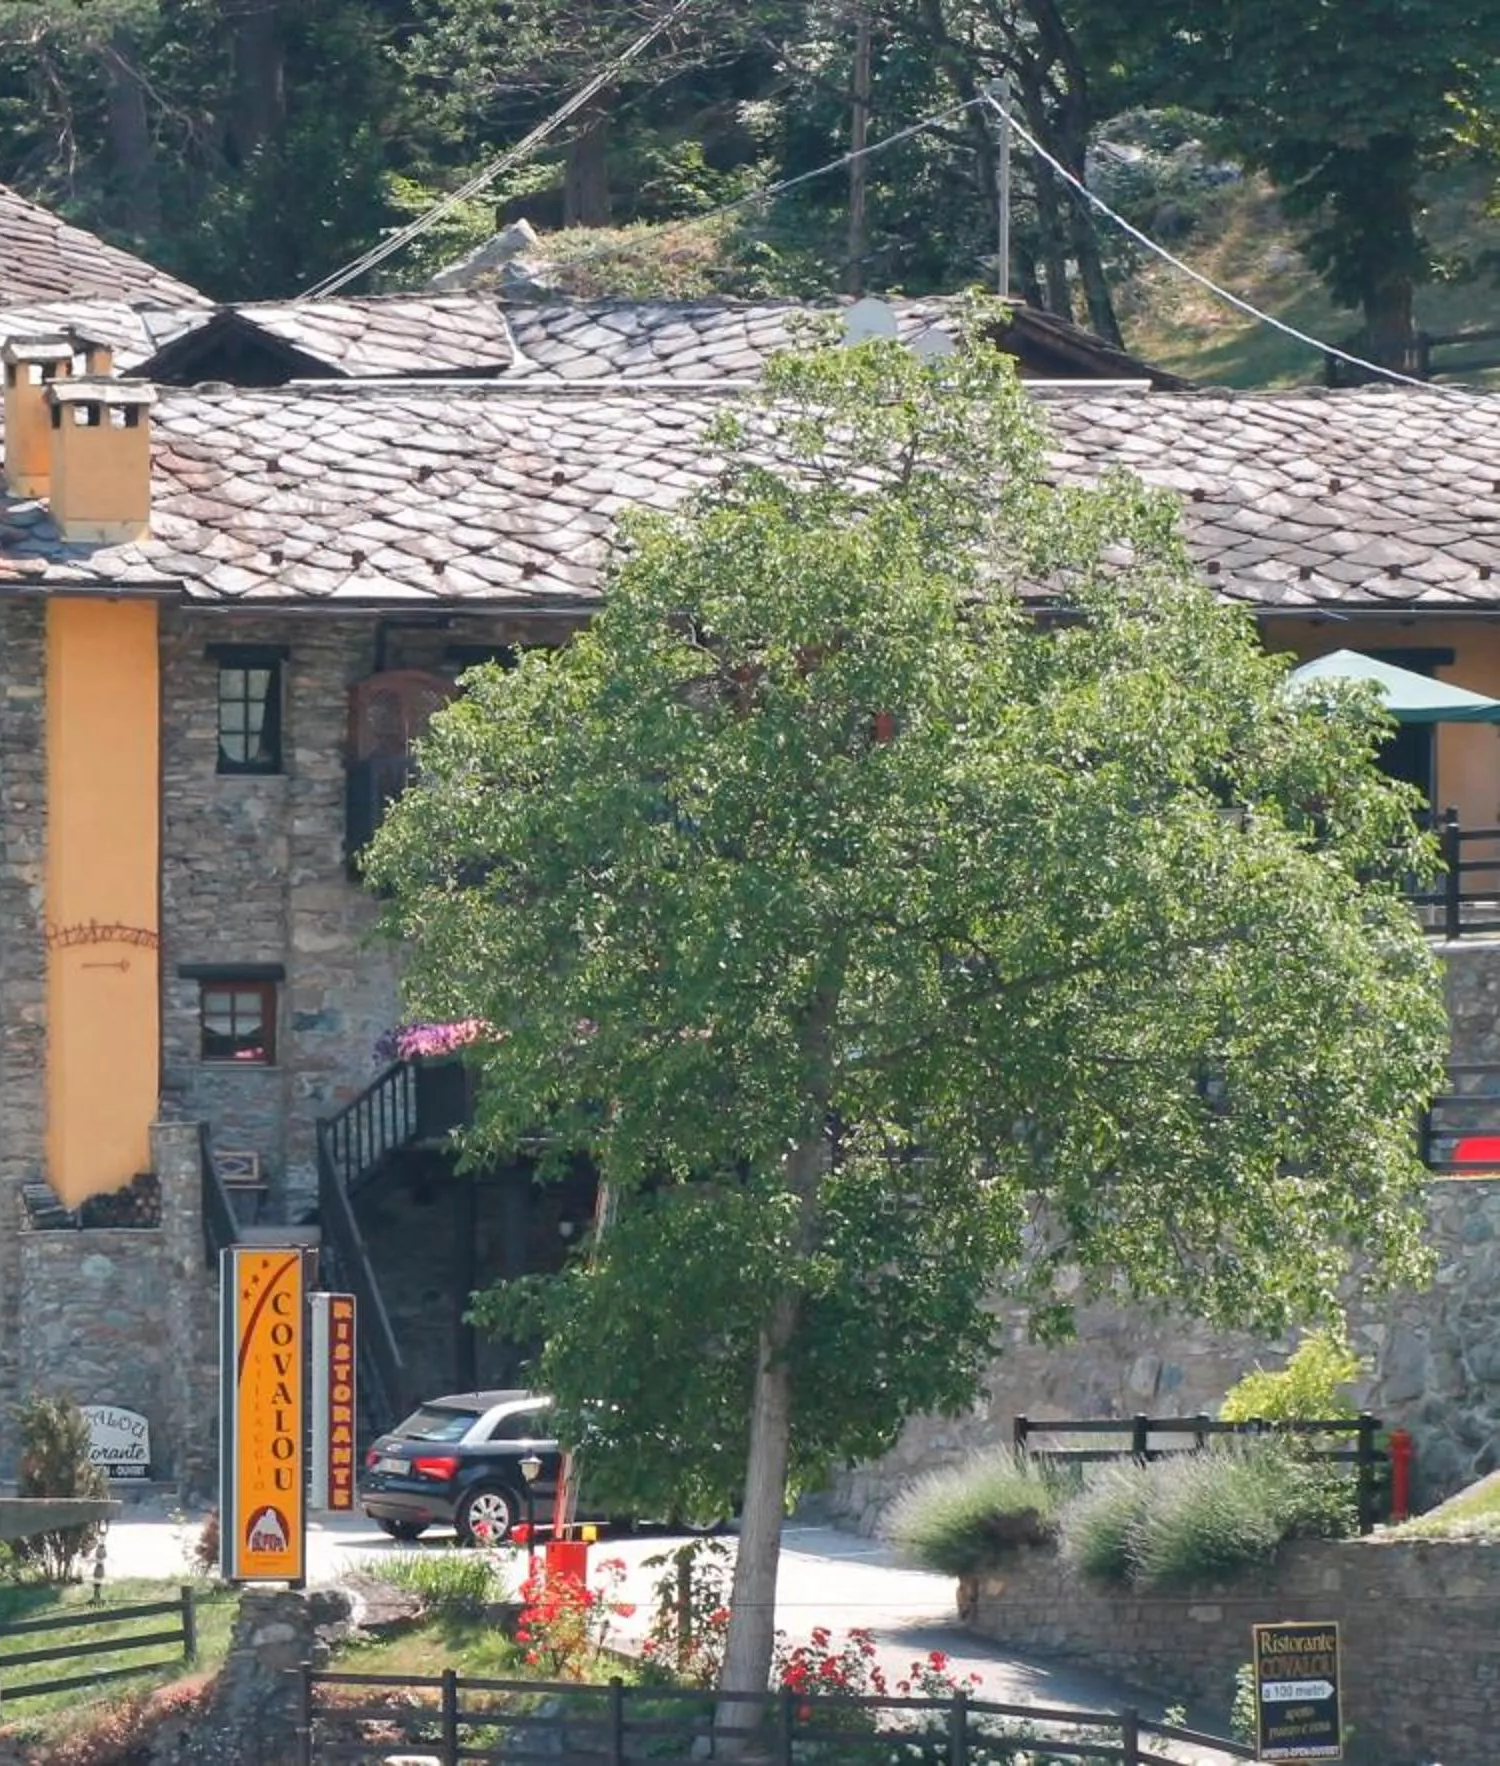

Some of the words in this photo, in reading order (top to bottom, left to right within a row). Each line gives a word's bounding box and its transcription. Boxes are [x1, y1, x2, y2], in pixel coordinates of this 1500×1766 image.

[271, 1291, 295, 1490] COVALOU
[332, 1301, 352, 1506] RISTORANTE
[85, 1410, 144, 1438] ALOU
[1261, 1631, 1334, 1654] Ristorante
[1260, 1654, 1334, 1679] COVALOU
[1274, 1685, 1293, 1698] 100
[1296, 1683, 1326, 1697] metri
